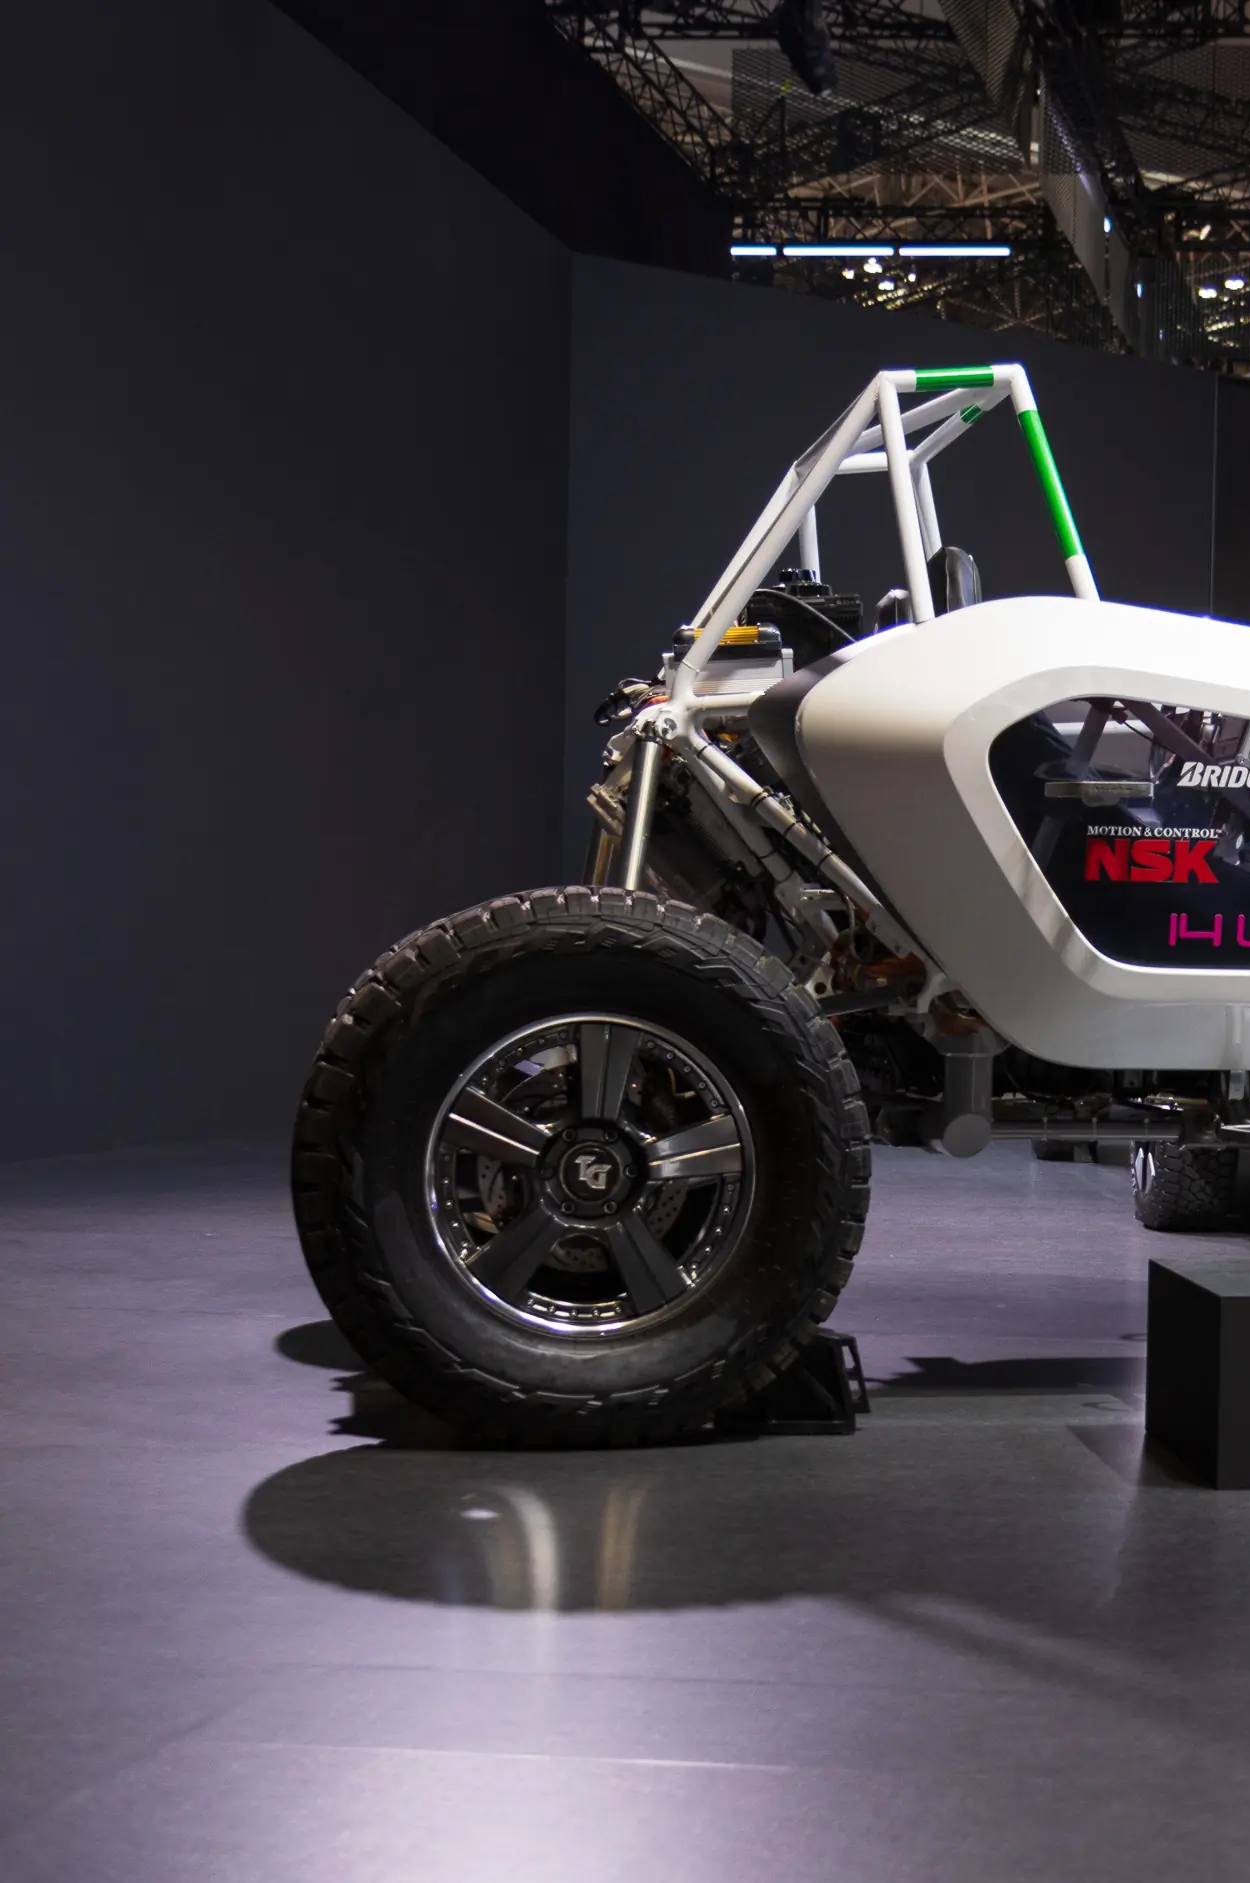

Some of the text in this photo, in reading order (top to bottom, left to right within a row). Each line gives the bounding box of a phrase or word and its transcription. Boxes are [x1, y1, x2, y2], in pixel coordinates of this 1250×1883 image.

[1087, 825, 1143, 837] MOTION
[1144, 827, 1152, 837] &
[1085, 838, 1219, 884] NSK
